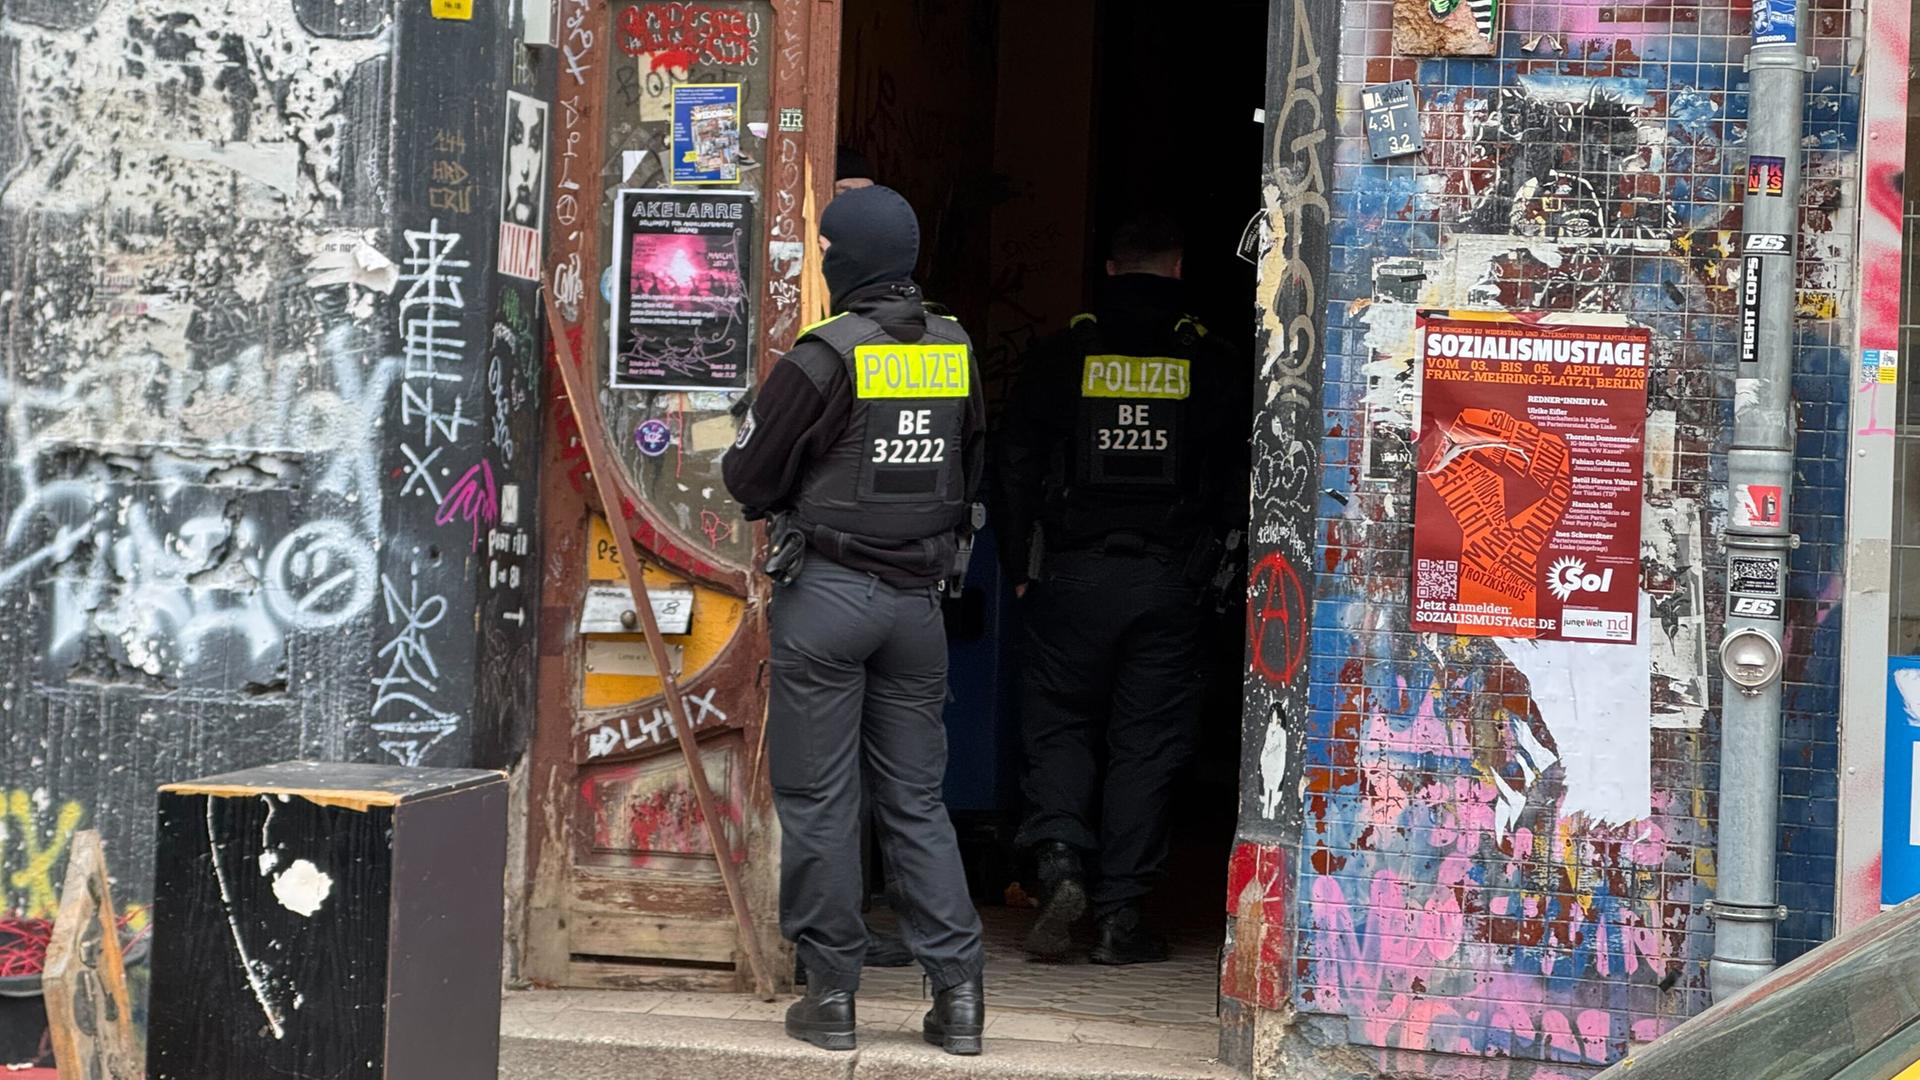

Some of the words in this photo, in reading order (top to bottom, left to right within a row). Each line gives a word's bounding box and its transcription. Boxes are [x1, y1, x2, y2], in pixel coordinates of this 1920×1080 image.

[1374, 92, 1384, 107] A
[778, 113, 804, 127] HR
[632, 201, 742, 219] AKELARRE
[1746, 257, 1759, 306] COPS
[1603, 334, 1647, 342] KAPITALISMUS
[1743, 308, 1755, 360] FIGHT
[1427, 333, 1646, 366] SOZIALISMUSTAGE
[864, 352, 965, 390] POLIZEI
[1088, 360, 1186, 395] POLIZEI
[1427, 358, 1460, 369] VOM
[1471, 360, 1488, 371] 03.
[1500, 362, 1522, 372] BIS
[1534, 364, 1552, 374] 05.
[1564, 364, 1604, 376] APRIL
[1615, 367, 1646, 378] 2026
[1596, 378, 1645, 390] BERLIN
[1550, 408, 1568, 416] Eifler
[1592, 398, 1608, 406] U.A.
[898, 409, 932, 435] BE
[1117, 404, 1150, 426] BE
[1529, 414, 1580, 422] Gewerkschafterin
[1098, 428, 1168, 451] 32215
[1596, 434, 1640, 443] Donnermeier
[871, 438, 946, 464] 32222
[1531, 436, 1564, 489] ANTIFA
[1572, 458, 1594, 466] Fabian
[1596, 459, 1630, 467] Goldmann
[1462, 461, 1505, 526] FEMINISMUS
[1572, 500, 1598, 508] Hannah
[1499, 470, 1570, 583] REVOLUTION
[1556, 530, 1570, 538] Ines
[1570, 531, 1614, 540] Schwerdtner
[1462, 520, 1520, 572] MARX
[1461, 562, 1526, 602] TROTZKISMUS
[1488, 561, 1534, 593] GESCHICHTE
[1562, 567, 1614, 592] Sol
[1416, 600, 1446, 612] Jetzt
[1449, 601, 1512, 614] anmelden:
[1416, 612, 1556, 630] SOZIALISMUSTAGE.DE
[1608, 616, 1629, 630] nd
